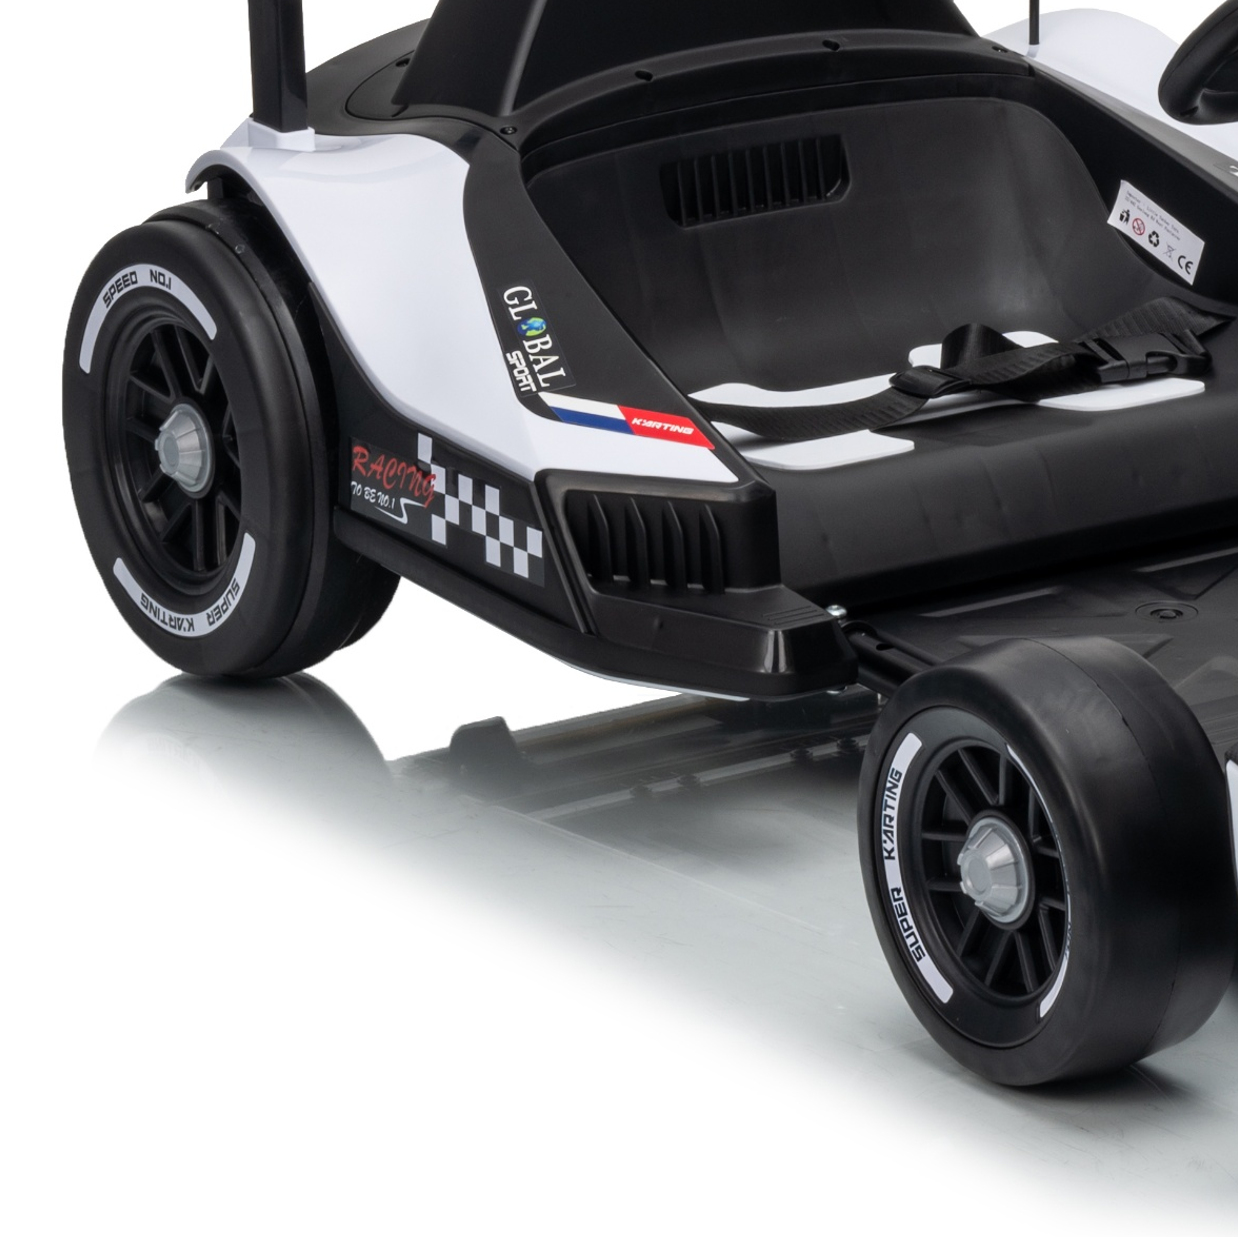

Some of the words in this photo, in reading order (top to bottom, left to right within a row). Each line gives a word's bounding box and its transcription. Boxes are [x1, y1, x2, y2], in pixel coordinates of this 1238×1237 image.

[103, 270, 138, 309] SPEED
[505, 350, 537, 392] SPORT
[351, 481, 362, 497] TO
[363, 486, 377, 503] BE
[352, 445, 437, 508] RACING
[206, 578, 241, 627] SUPER
[891, 886, 926, 962] SUPER
